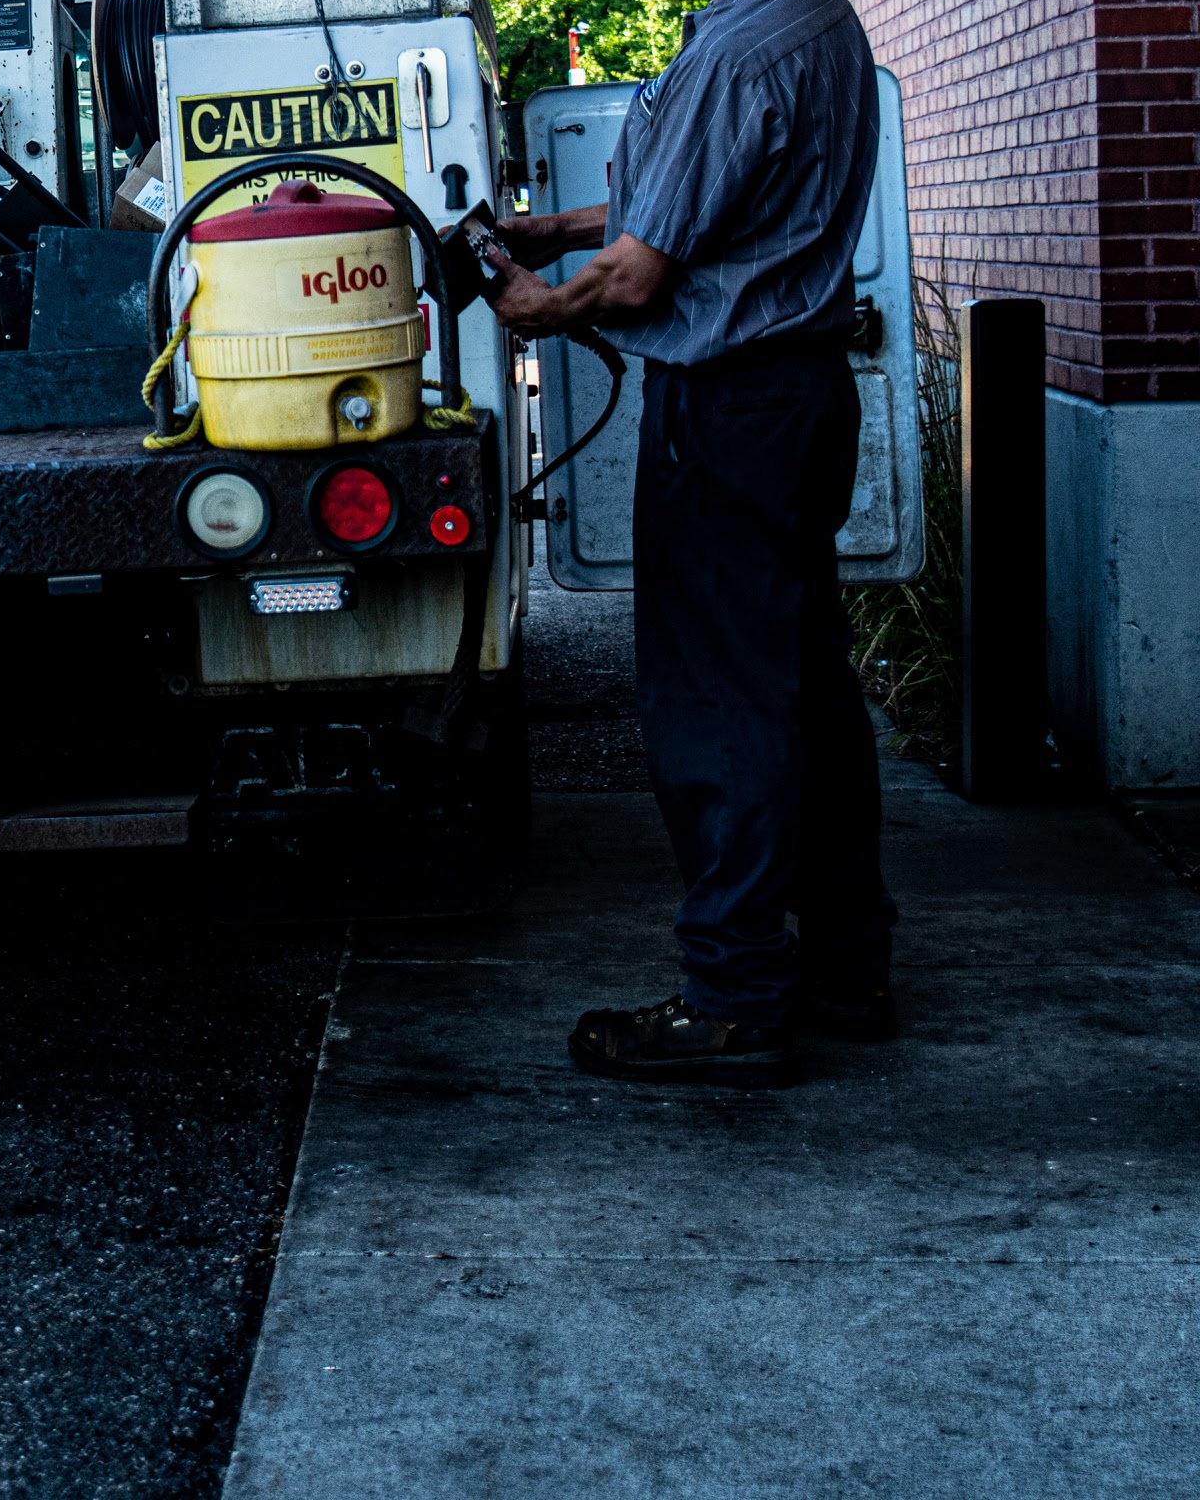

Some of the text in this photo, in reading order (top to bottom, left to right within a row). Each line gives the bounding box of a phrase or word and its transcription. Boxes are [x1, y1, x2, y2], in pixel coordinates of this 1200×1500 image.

[190, 89, 389, 153] CAUTION
[277, 162, 366, 184] VEHIC
[301, 256, 387, 304] igloo
[306, 337, 366, 349] INDUSTRIAL
[311, 348, 365, 360] DRINKING
